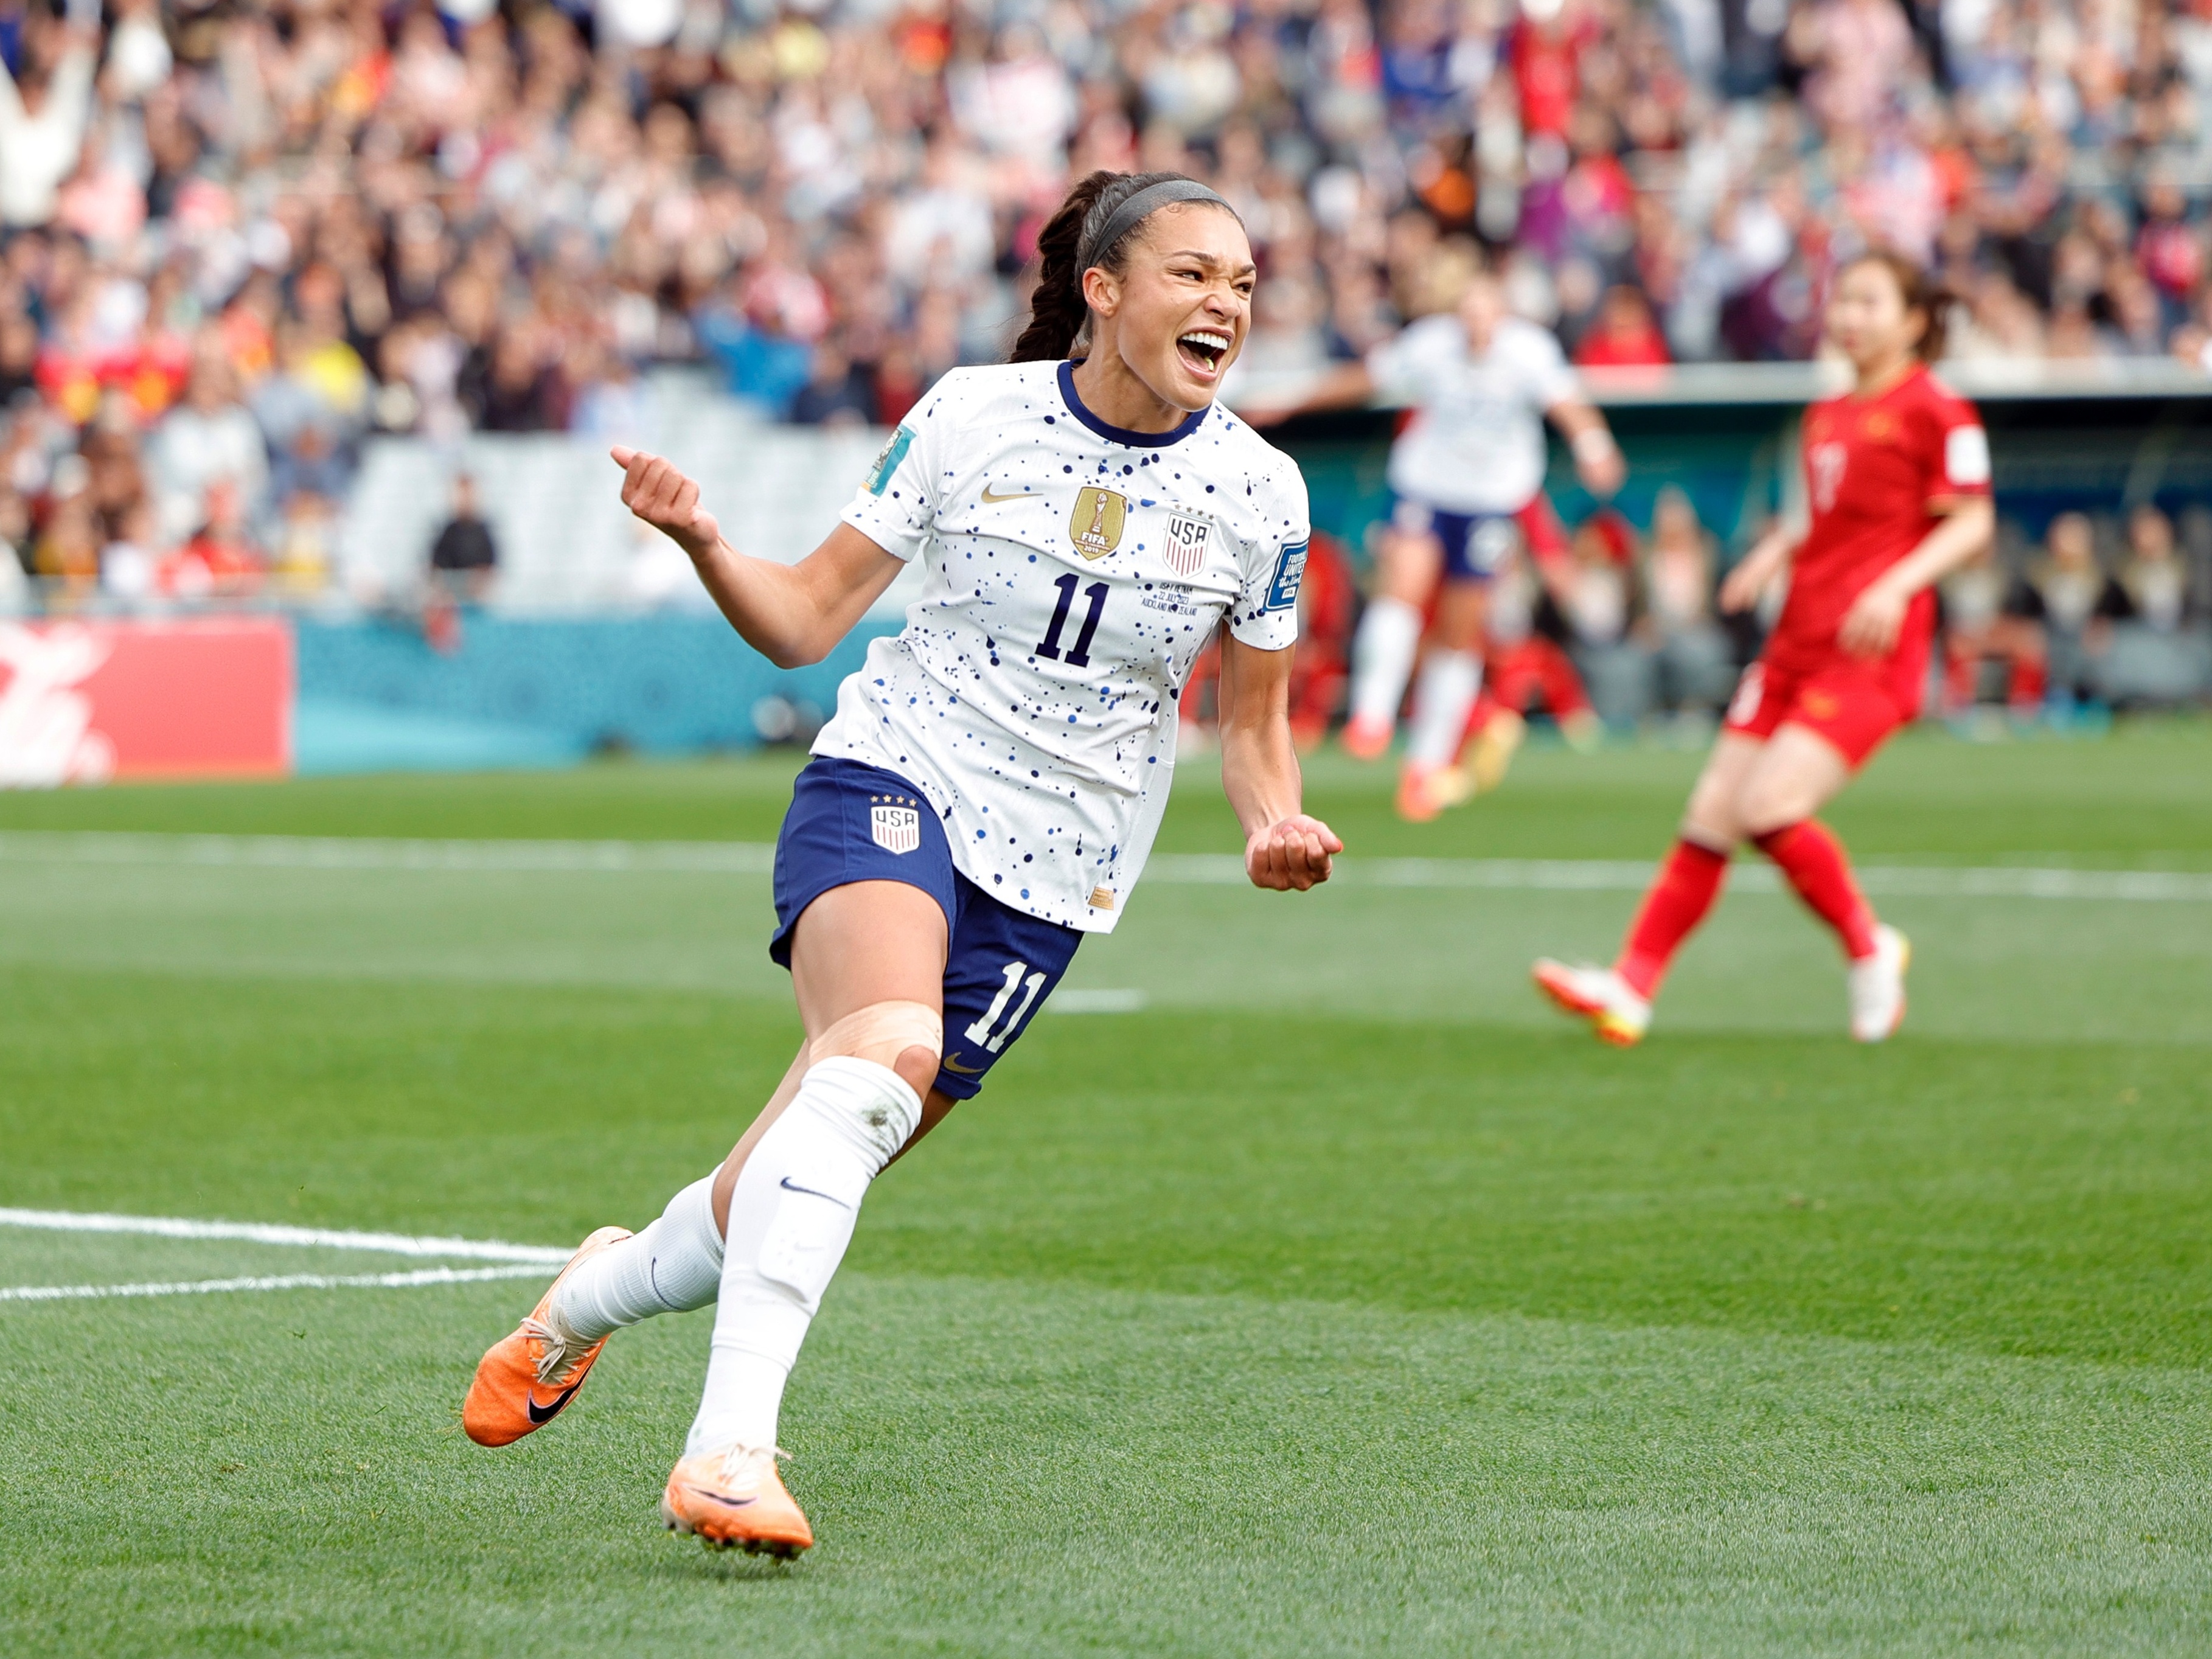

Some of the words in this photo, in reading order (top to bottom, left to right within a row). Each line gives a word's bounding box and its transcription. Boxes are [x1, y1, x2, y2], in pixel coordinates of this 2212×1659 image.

[1082, 532, 1105, 546] FIFA
[1170, 518, 1208, 545] USA
[1084, 545, 1099, 554] 2019
[1035, 572, 1110, 668] 11
[875, 810, 914, 827] USA
[964, 961, 1047, 1054] 11
